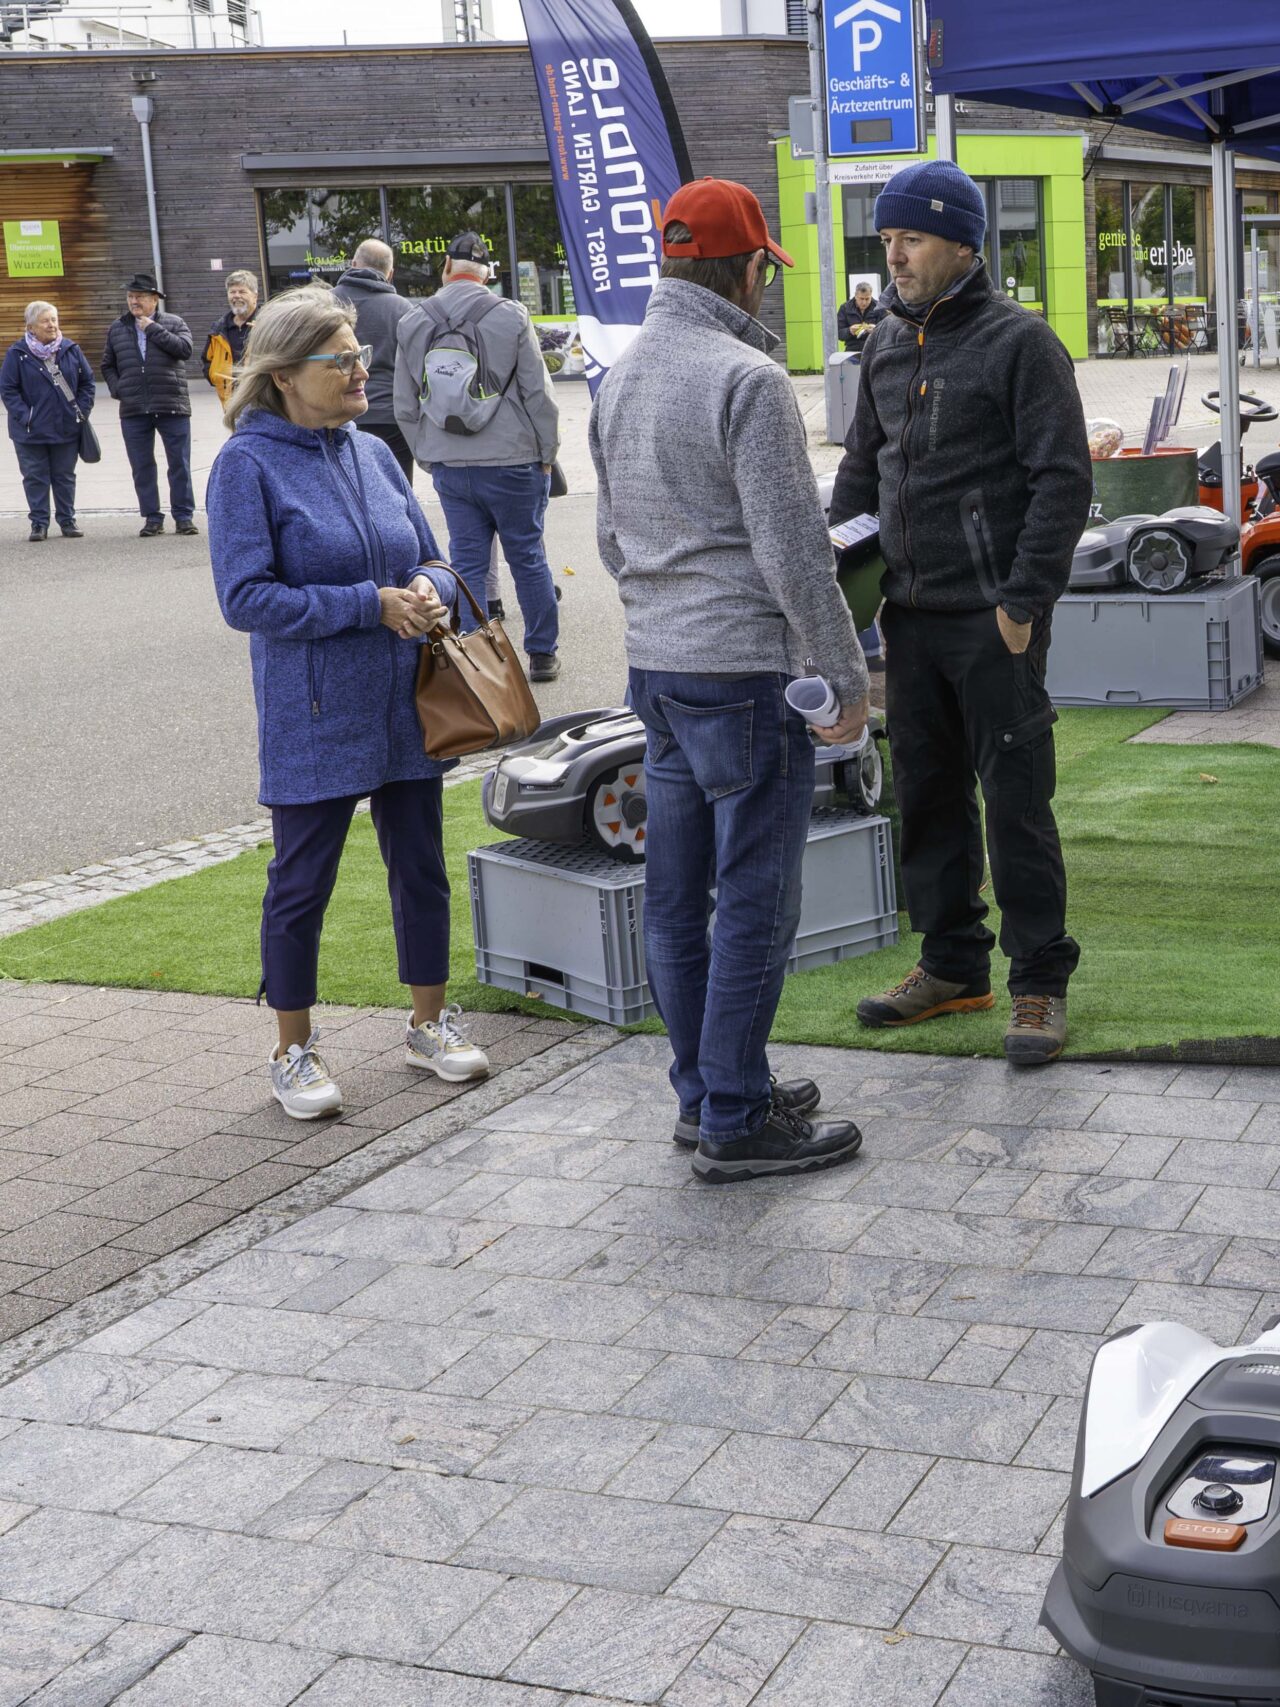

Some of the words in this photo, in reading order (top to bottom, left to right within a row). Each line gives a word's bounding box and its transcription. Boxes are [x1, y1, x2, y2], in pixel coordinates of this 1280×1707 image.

[852, 20, 883, 72] P
[830, 75, 895, 92] Geschäfts-
[900, 72, 910, 87] &
[830, 96, 913, 114] Ärztezentrum
[834, 173, 874, 181] Kreisverkehr
[400, 233, 494, 254] natüh
[1134, 247, 1149, 260] und
[1149, 240, 1194, 266] erlebe
[13, 258, 60, 270] Wurzeln
[929, 390, 942, 452] Husqvarna
[1177, 1522, 1230, 1535] STOP
[1147, 1588, 1250, 1619] Husqvarna
